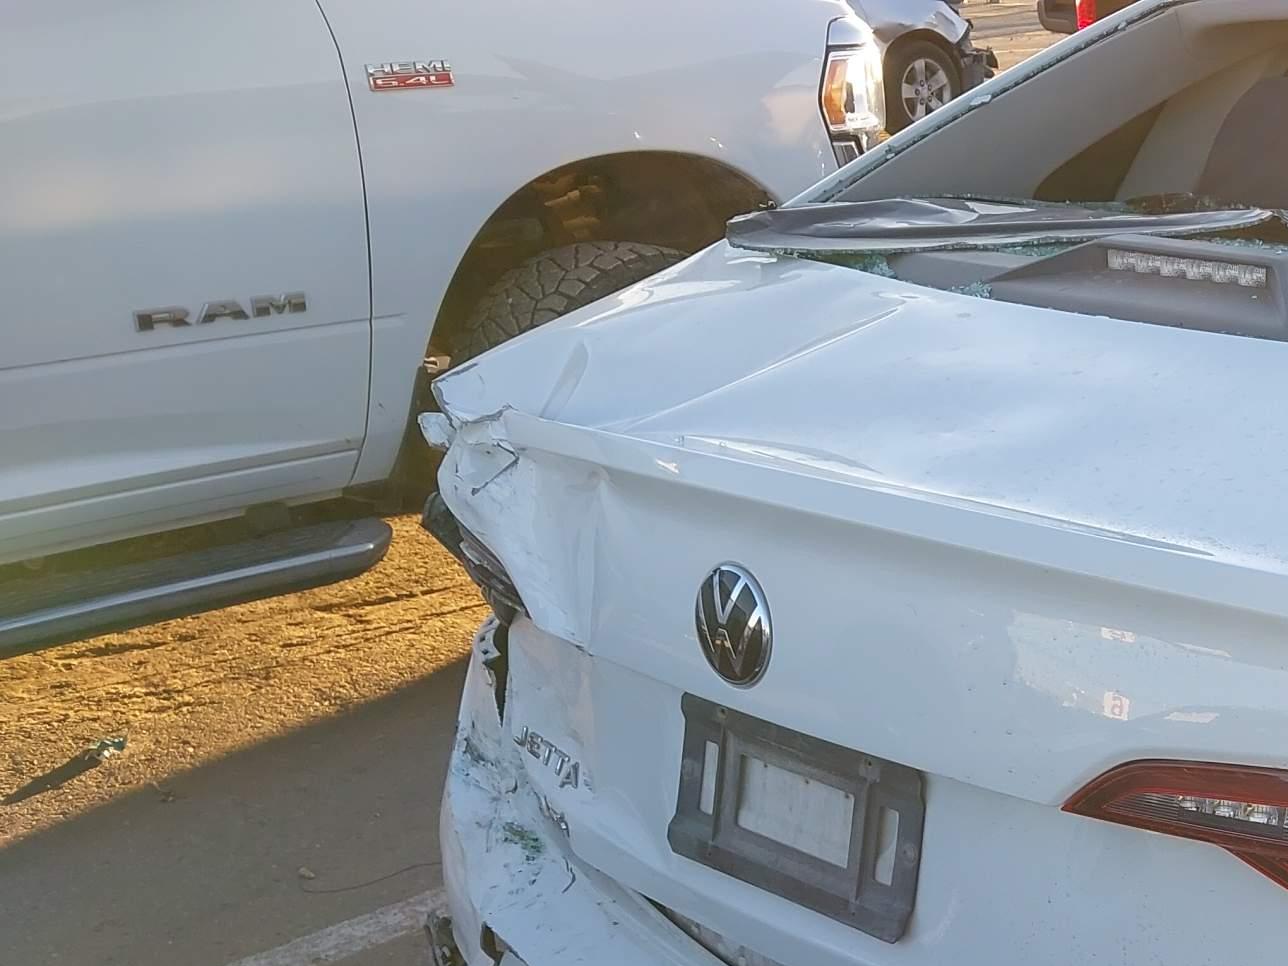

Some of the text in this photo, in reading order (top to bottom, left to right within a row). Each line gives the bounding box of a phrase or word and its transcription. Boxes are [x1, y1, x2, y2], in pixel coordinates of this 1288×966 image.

[364, 59, 452, 76] HEMI
[133, 291, 307, 332] RAM
[513, 725, 580, 789] JETTA
